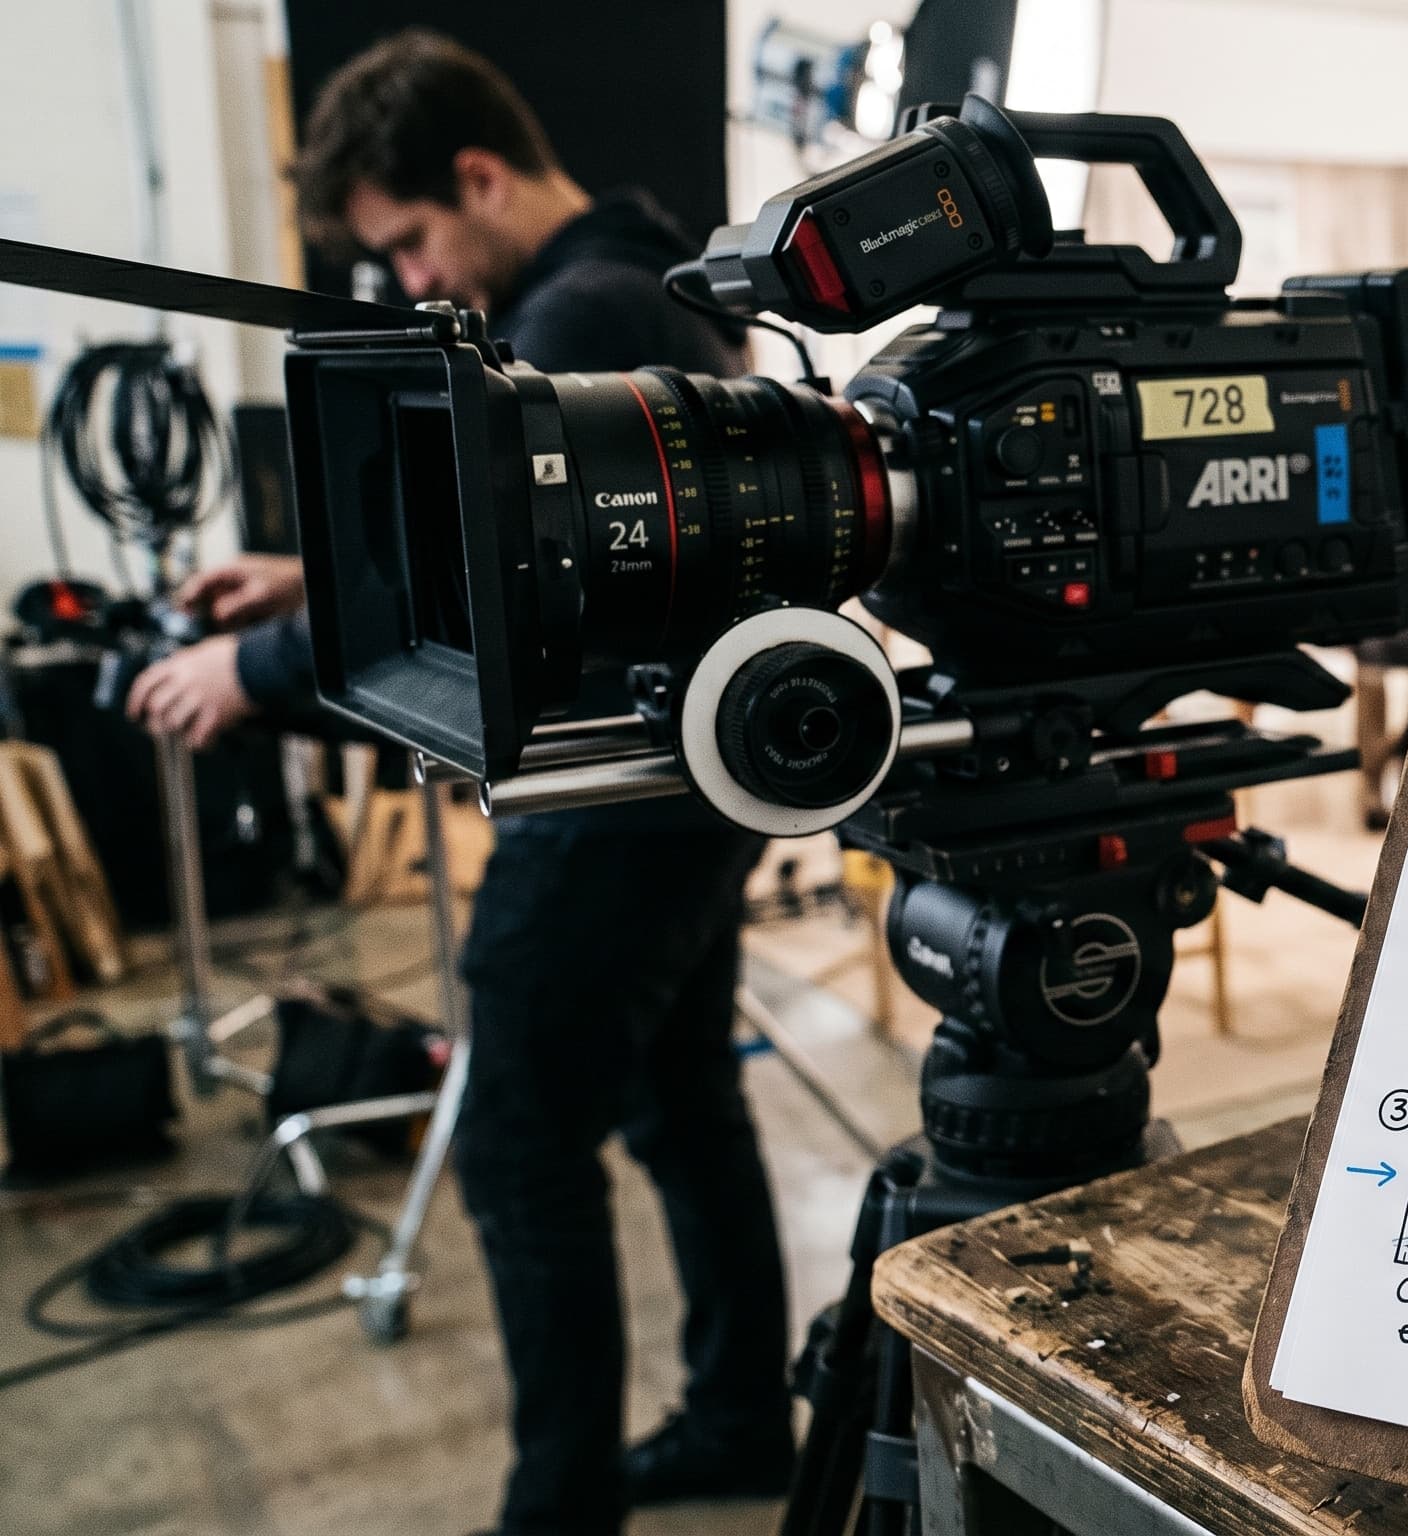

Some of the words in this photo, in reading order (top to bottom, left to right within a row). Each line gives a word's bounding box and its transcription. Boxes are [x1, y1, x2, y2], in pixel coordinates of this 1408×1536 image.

[1174, 384, 1245, 427] 728
[595, 491, 658, 508] Canon
[1187, 454, 1290, 508] ARRI
[609, 519, 650, 551] 24
